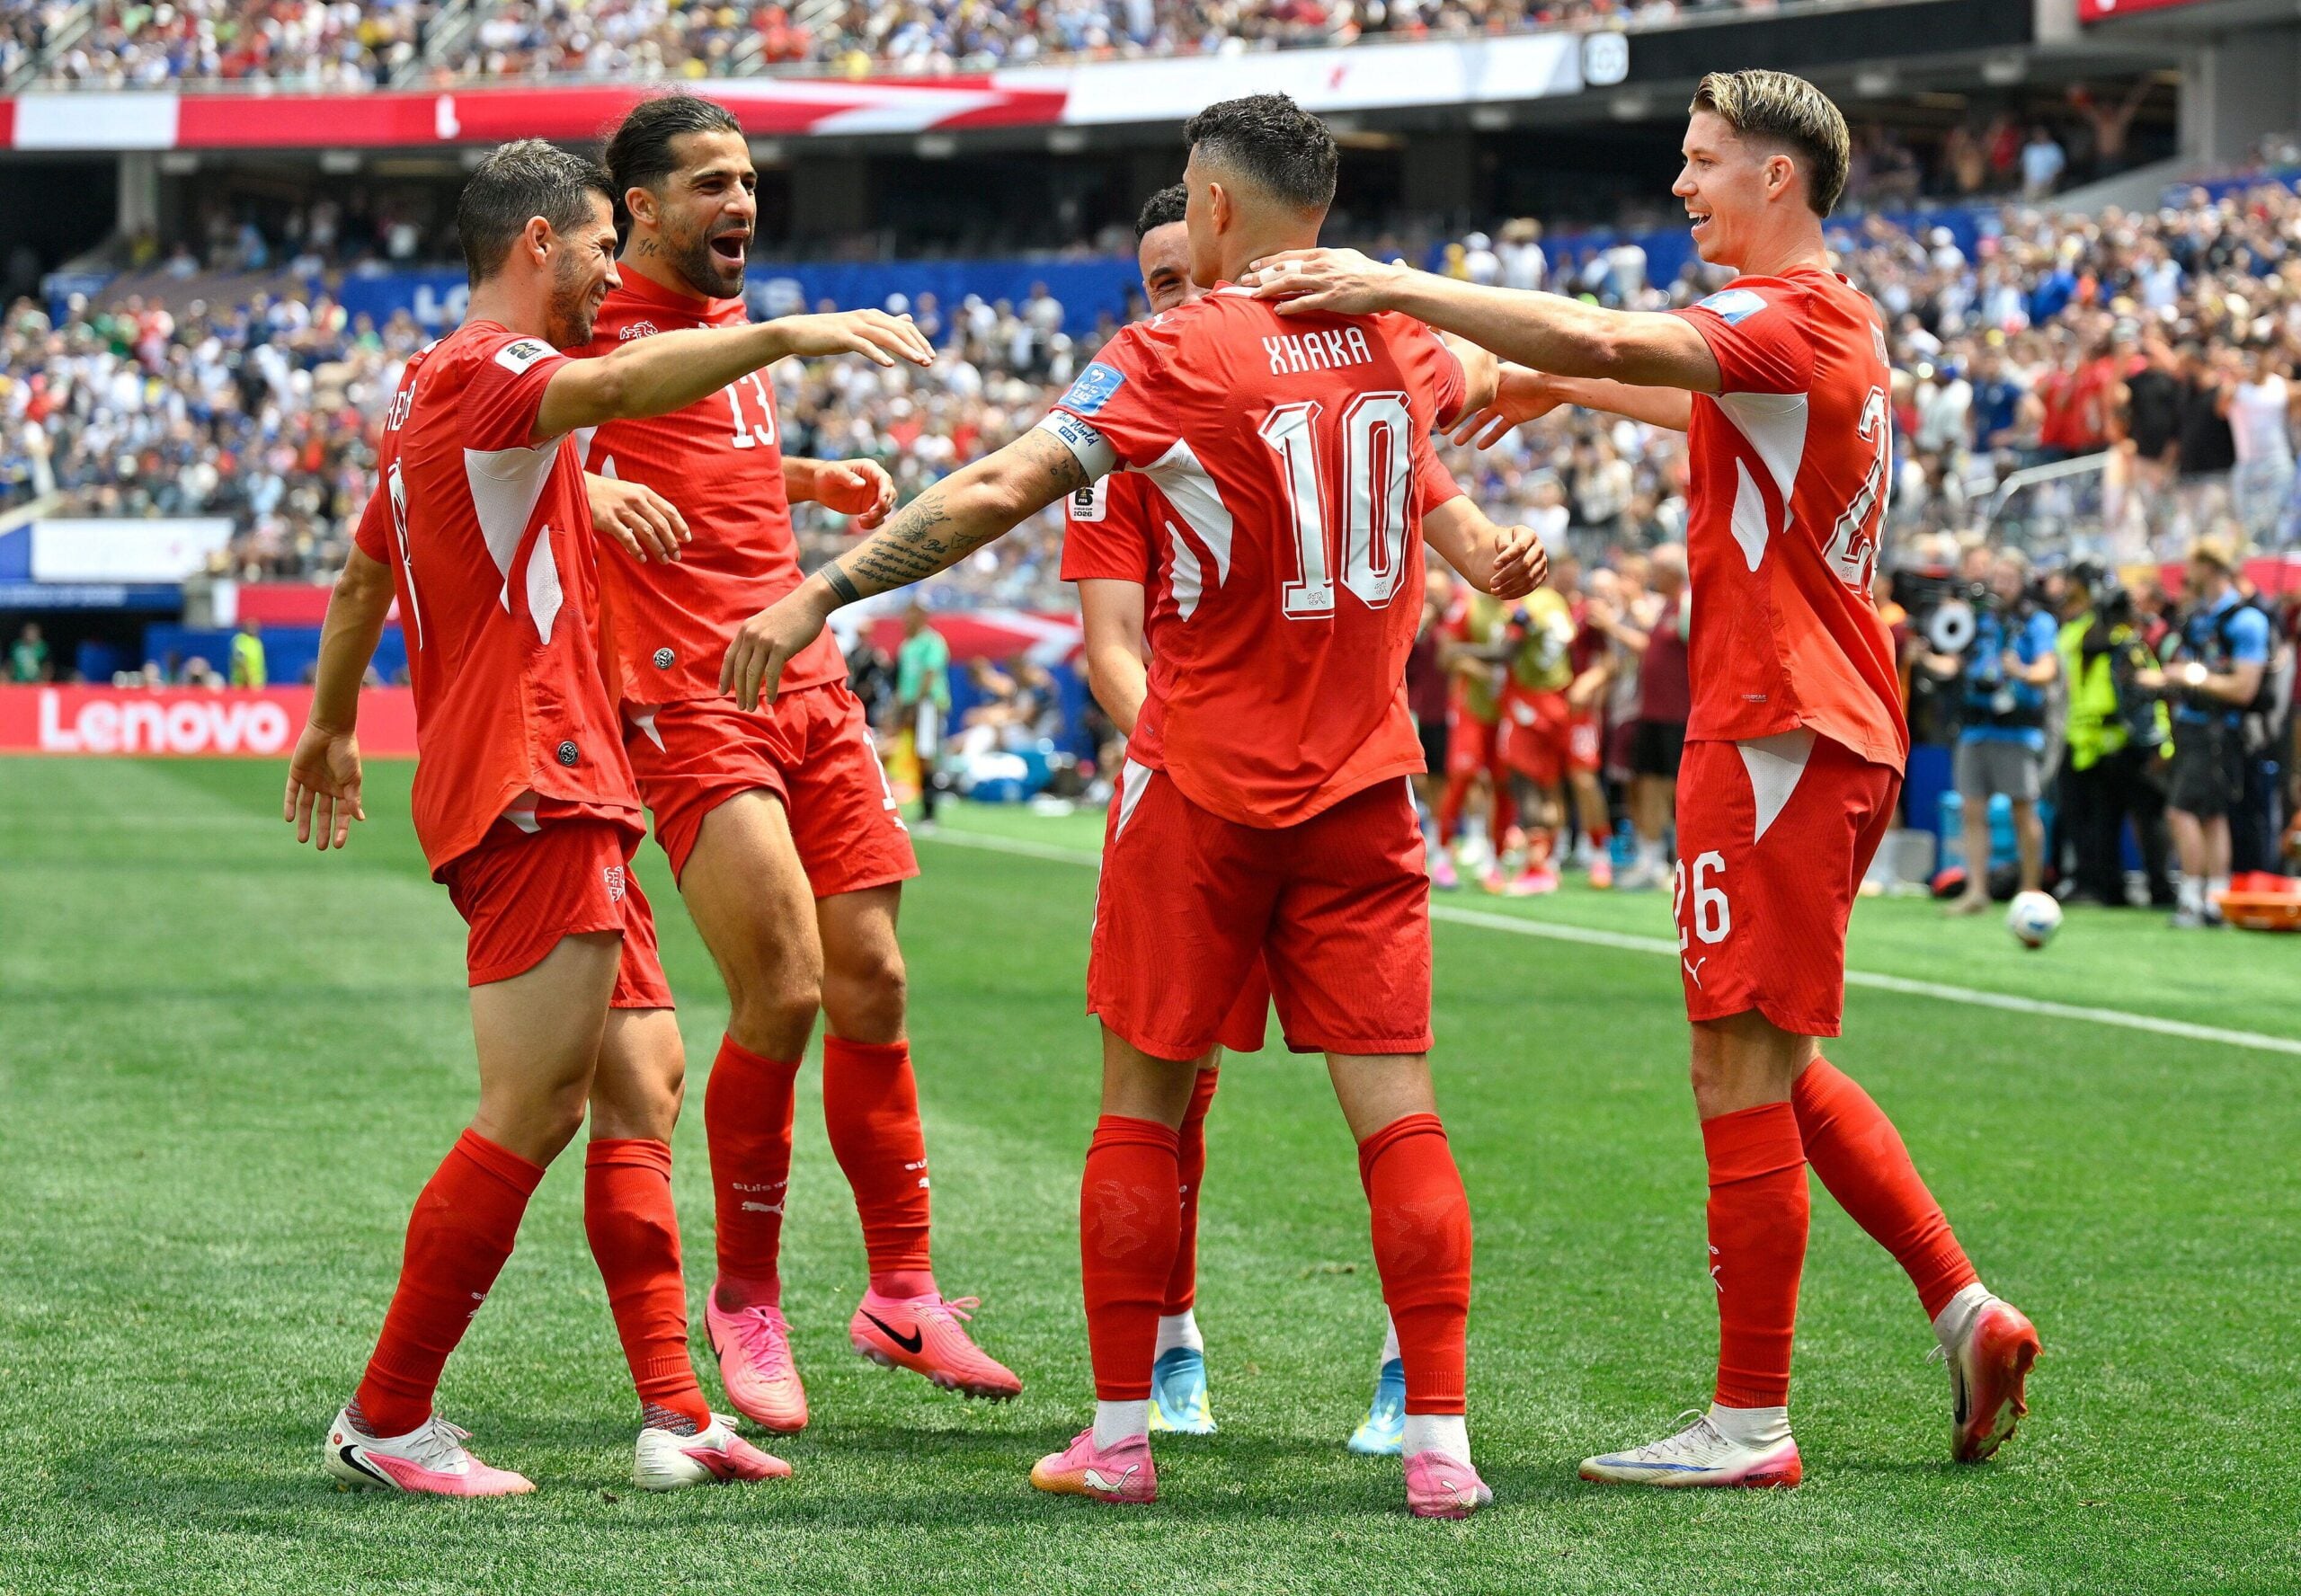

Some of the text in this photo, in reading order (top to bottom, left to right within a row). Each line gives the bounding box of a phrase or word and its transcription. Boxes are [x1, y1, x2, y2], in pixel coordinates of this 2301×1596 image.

[1261, 326, 1373, 376] XHAKA
[724, 371, 776, 448] 13
[1061, 428, 1076, 442] FIFA
[1070, 417, 1099, 447] World
[1257, 391, 1415, 621] 10
[1822, 385, 1892, 600] 2
[39, 687, 289, 753] Lenovo
[1673, 850, 1731, 952] 26
